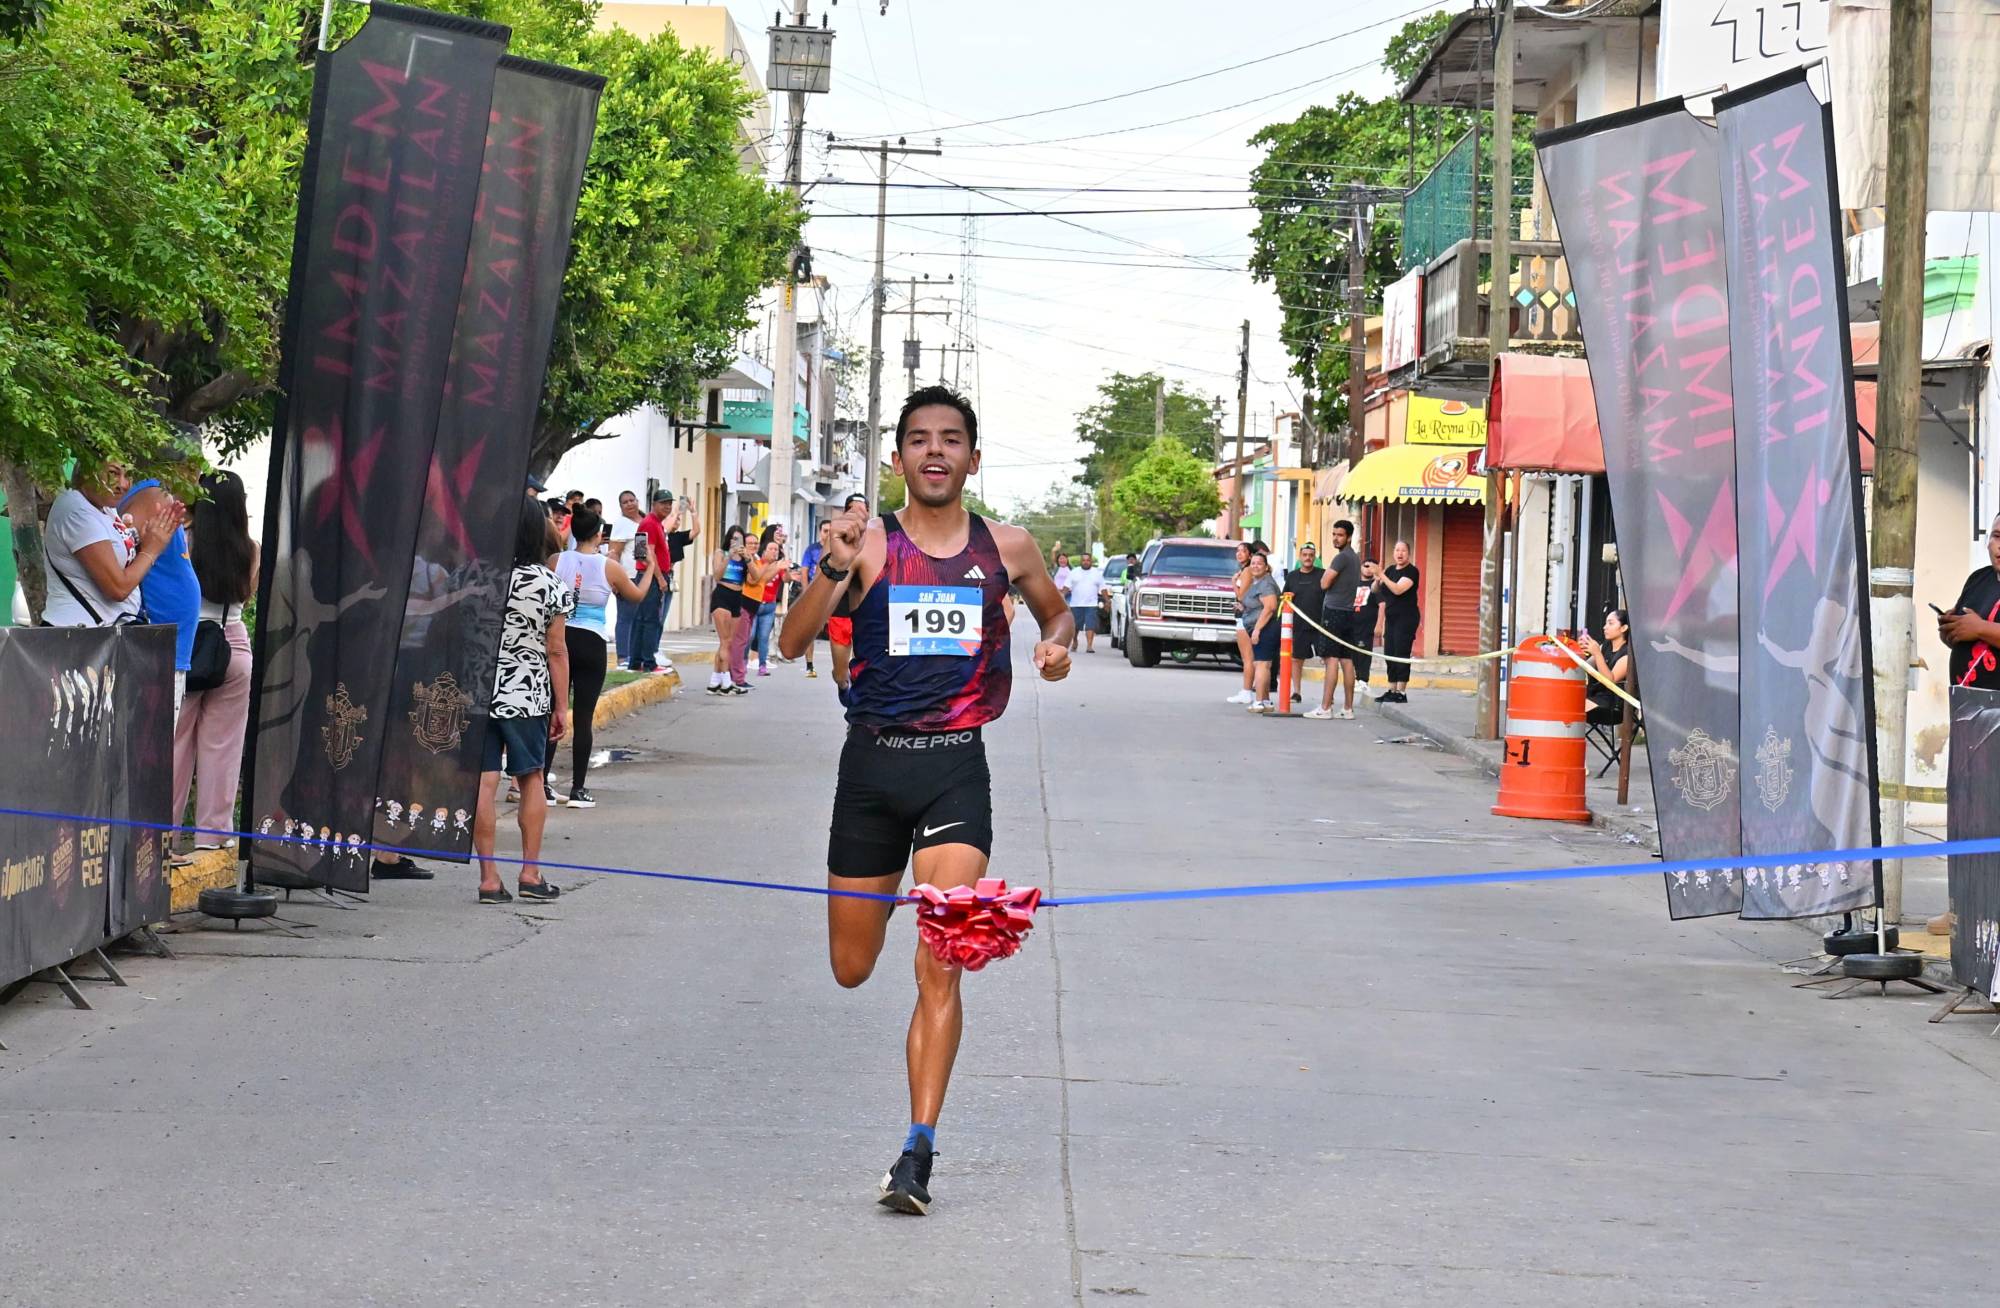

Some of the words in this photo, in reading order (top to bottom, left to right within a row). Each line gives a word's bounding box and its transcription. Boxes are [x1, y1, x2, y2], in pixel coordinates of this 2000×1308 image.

[314, 58, 408, 376] IMDEM
[1413, 420, 1427, 439] La
[1430, 420, 1464, 440] Reyna
[1409, 488, 1425, 496] COCO
[919, 592, 934, 603] SAN
[935, 592, 955, 603] JUAN
[905, 609, 966, 635] 199
[876, 735, 928, 749] NIKE
[929, 731, 973, 748] PRO
